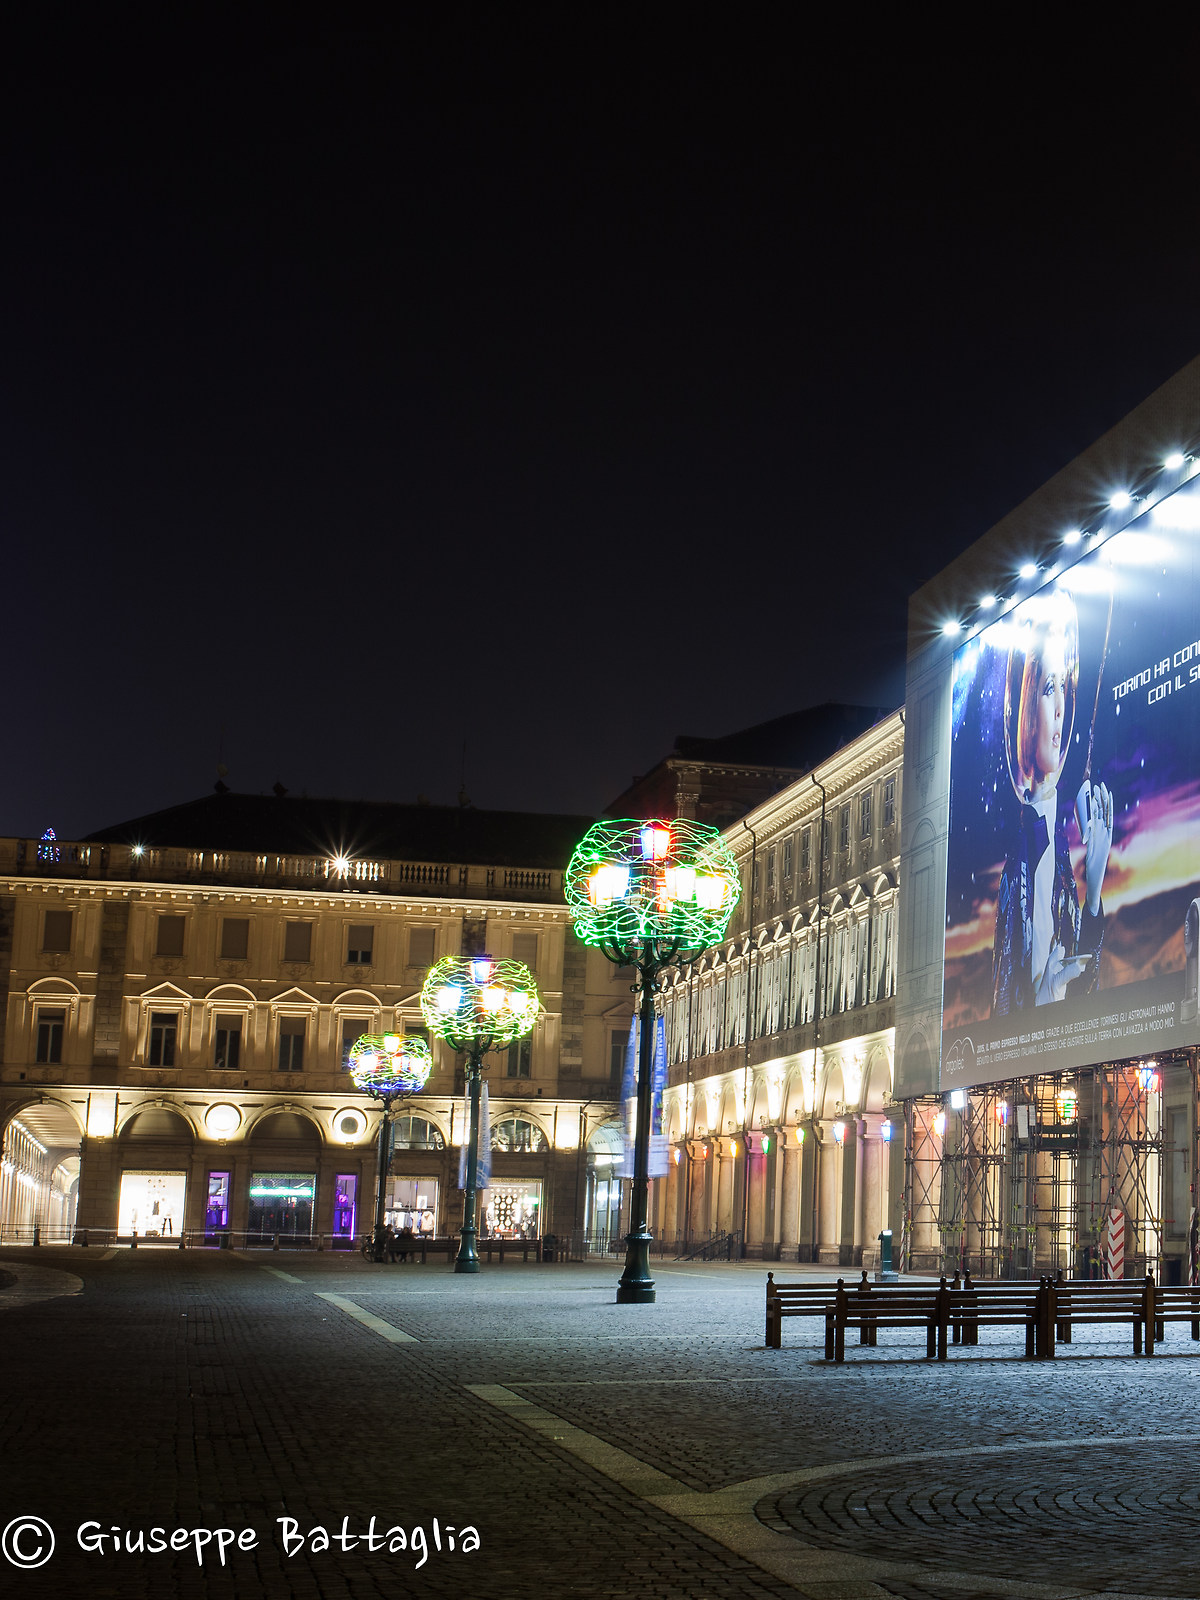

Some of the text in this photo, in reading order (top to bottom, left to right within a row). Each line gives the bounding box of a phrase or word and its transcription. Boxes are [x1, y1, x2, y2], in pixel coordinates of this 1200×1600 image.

[1112, 668, 1151, 700] TORINO
[1154, 657, 1170, 679] HA
[1148, 680, 1171, 705] CON
[1175, 675, 1185, 691] IL
